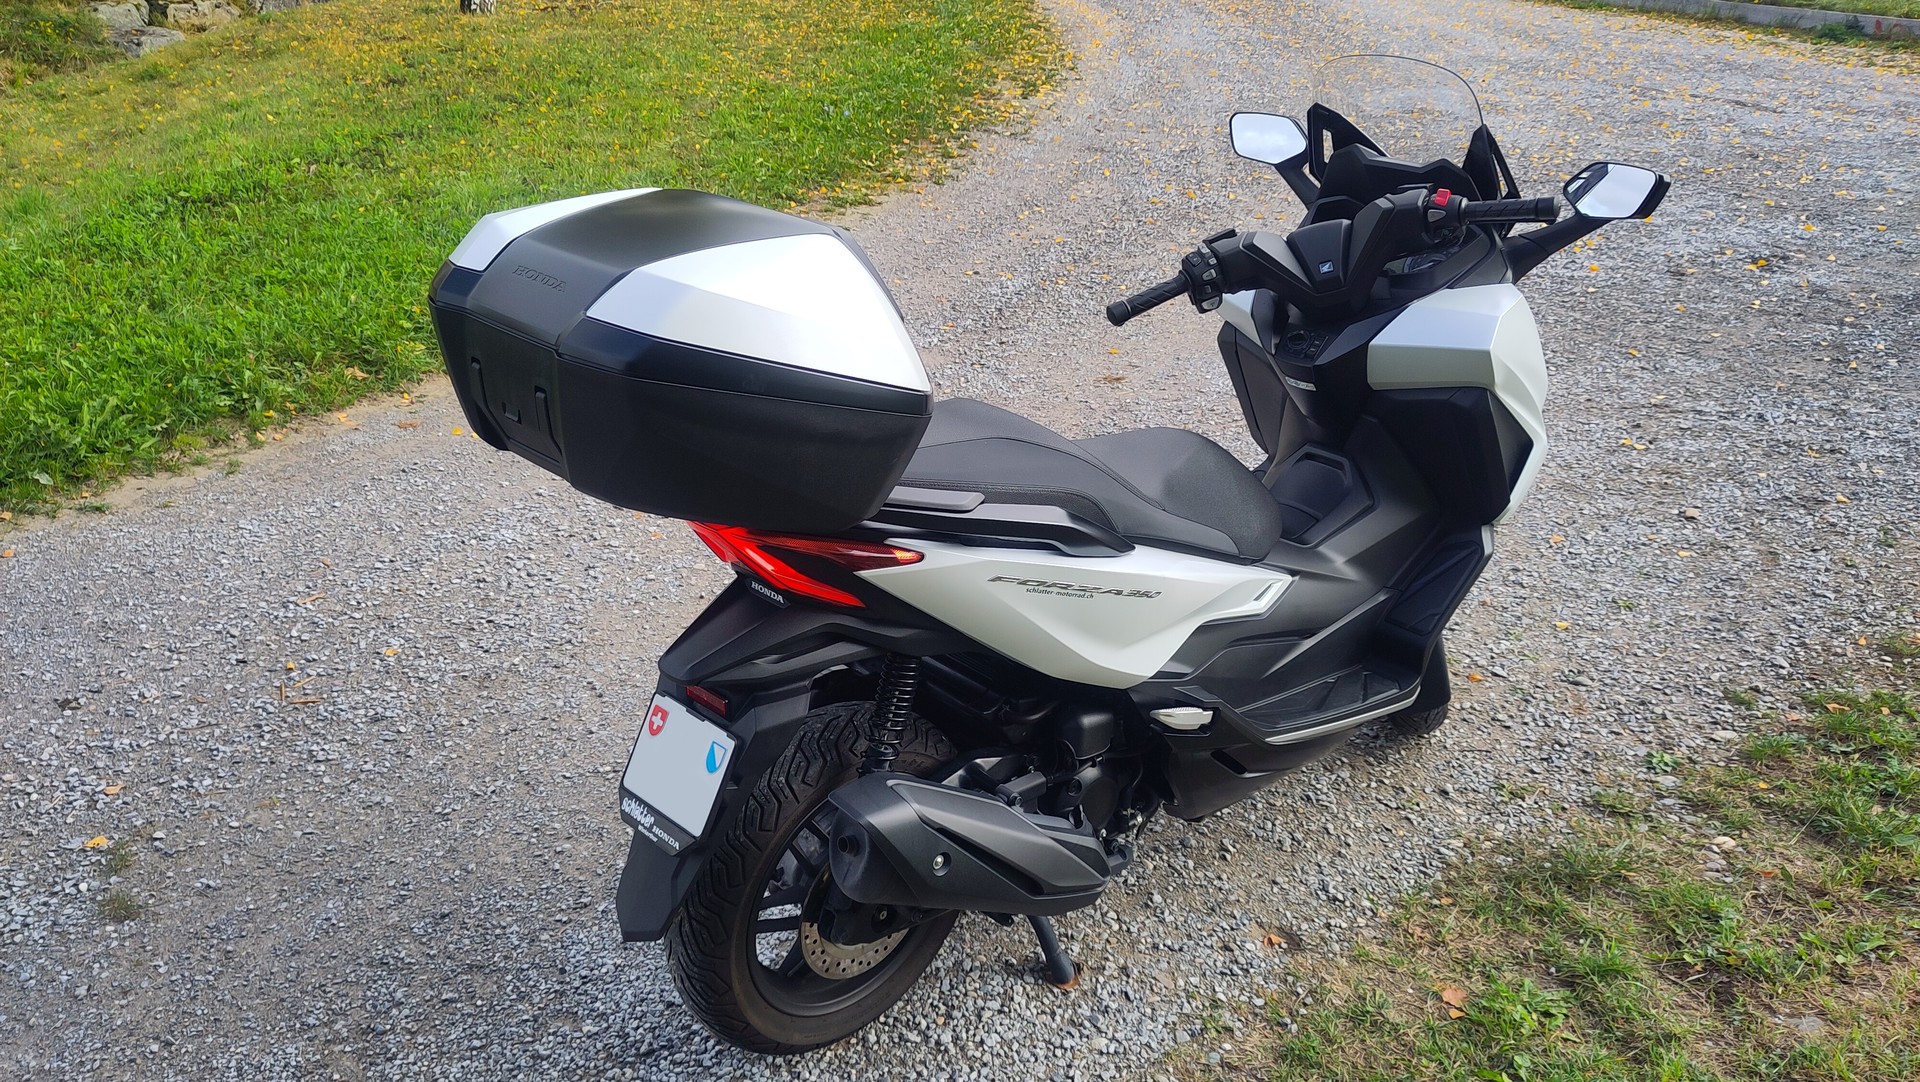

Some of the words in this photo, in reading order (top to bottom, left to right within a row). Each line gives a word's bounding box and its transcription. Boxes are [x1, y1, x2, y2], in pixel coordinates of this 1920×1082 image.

[512, 265, 566, 293] HONDA
[751, 580, 784, 604] HONDA
[987, 574, 1123, 595] FORZA
[1122, 588, 1162, 599] 350
[652, 825, 680, 850] HONDA
